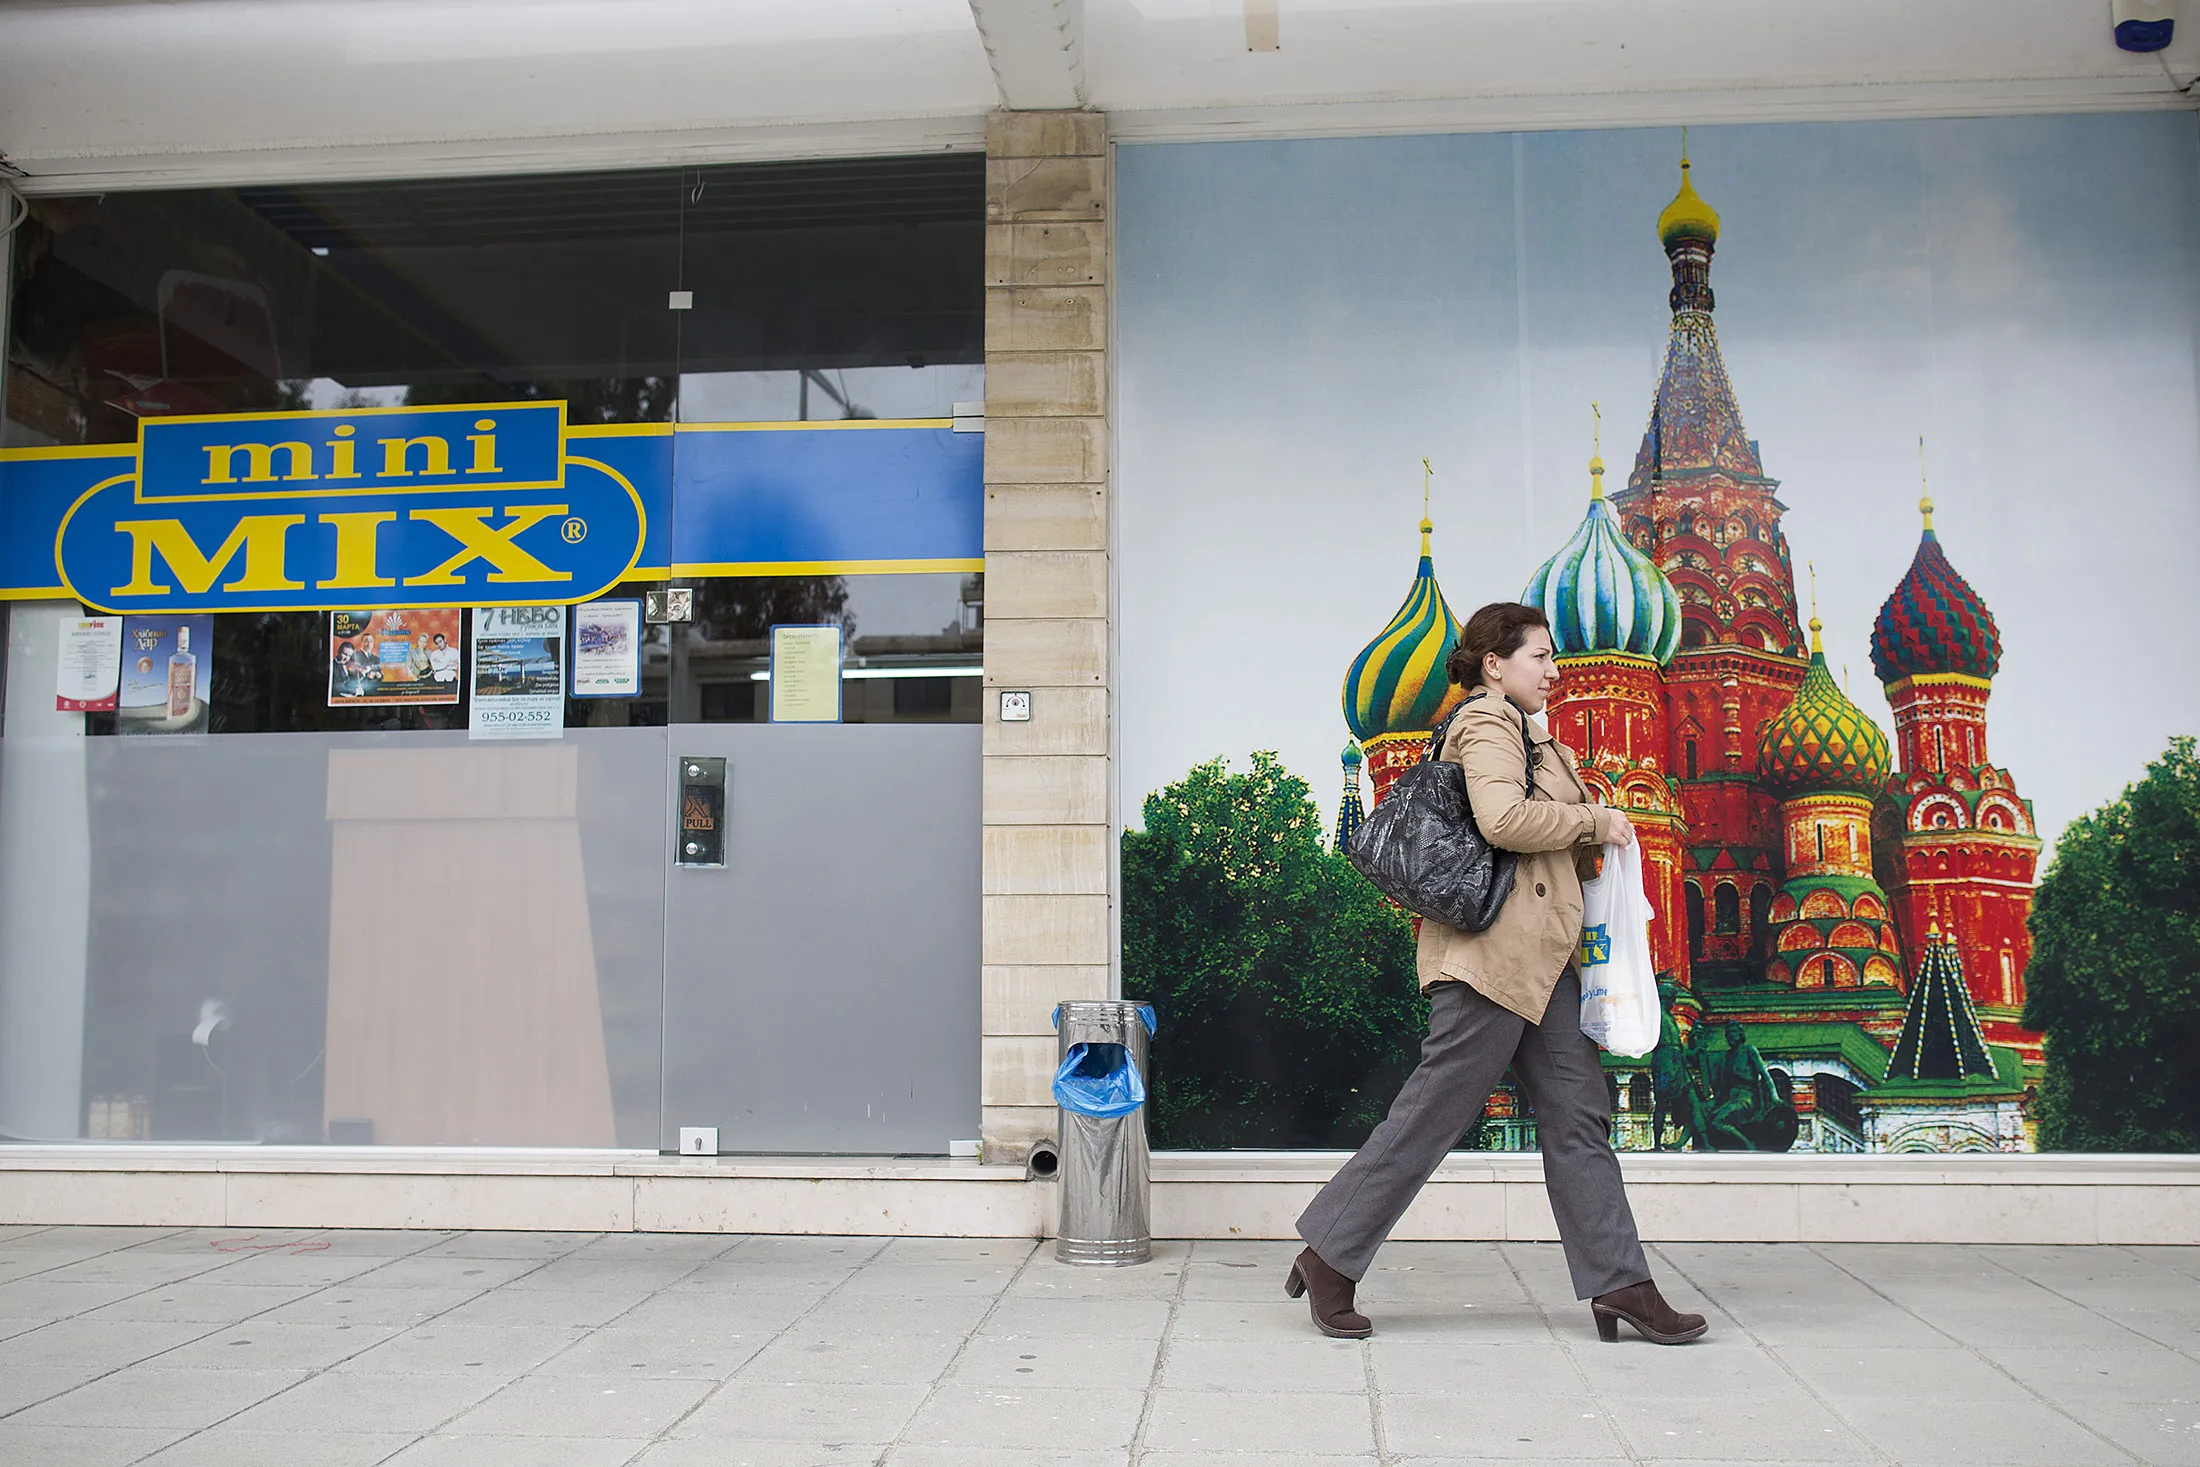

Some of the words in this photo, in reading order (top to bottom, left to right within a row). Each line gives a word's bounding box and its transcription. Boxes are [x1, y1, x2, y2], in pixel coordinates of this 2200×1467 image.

[201, 418, 504, 485] mini
[110, 503, 573, 597] MIX
[336, 614, 350, 624] 30
[480, 606, 495, 632] 7
[336, 623, 360, 631] МАРТА
[132, 637, 158, 651] Дар
[481, 711, 551, 722] 955-02-552
[685, 818, 712, 828] PULL
